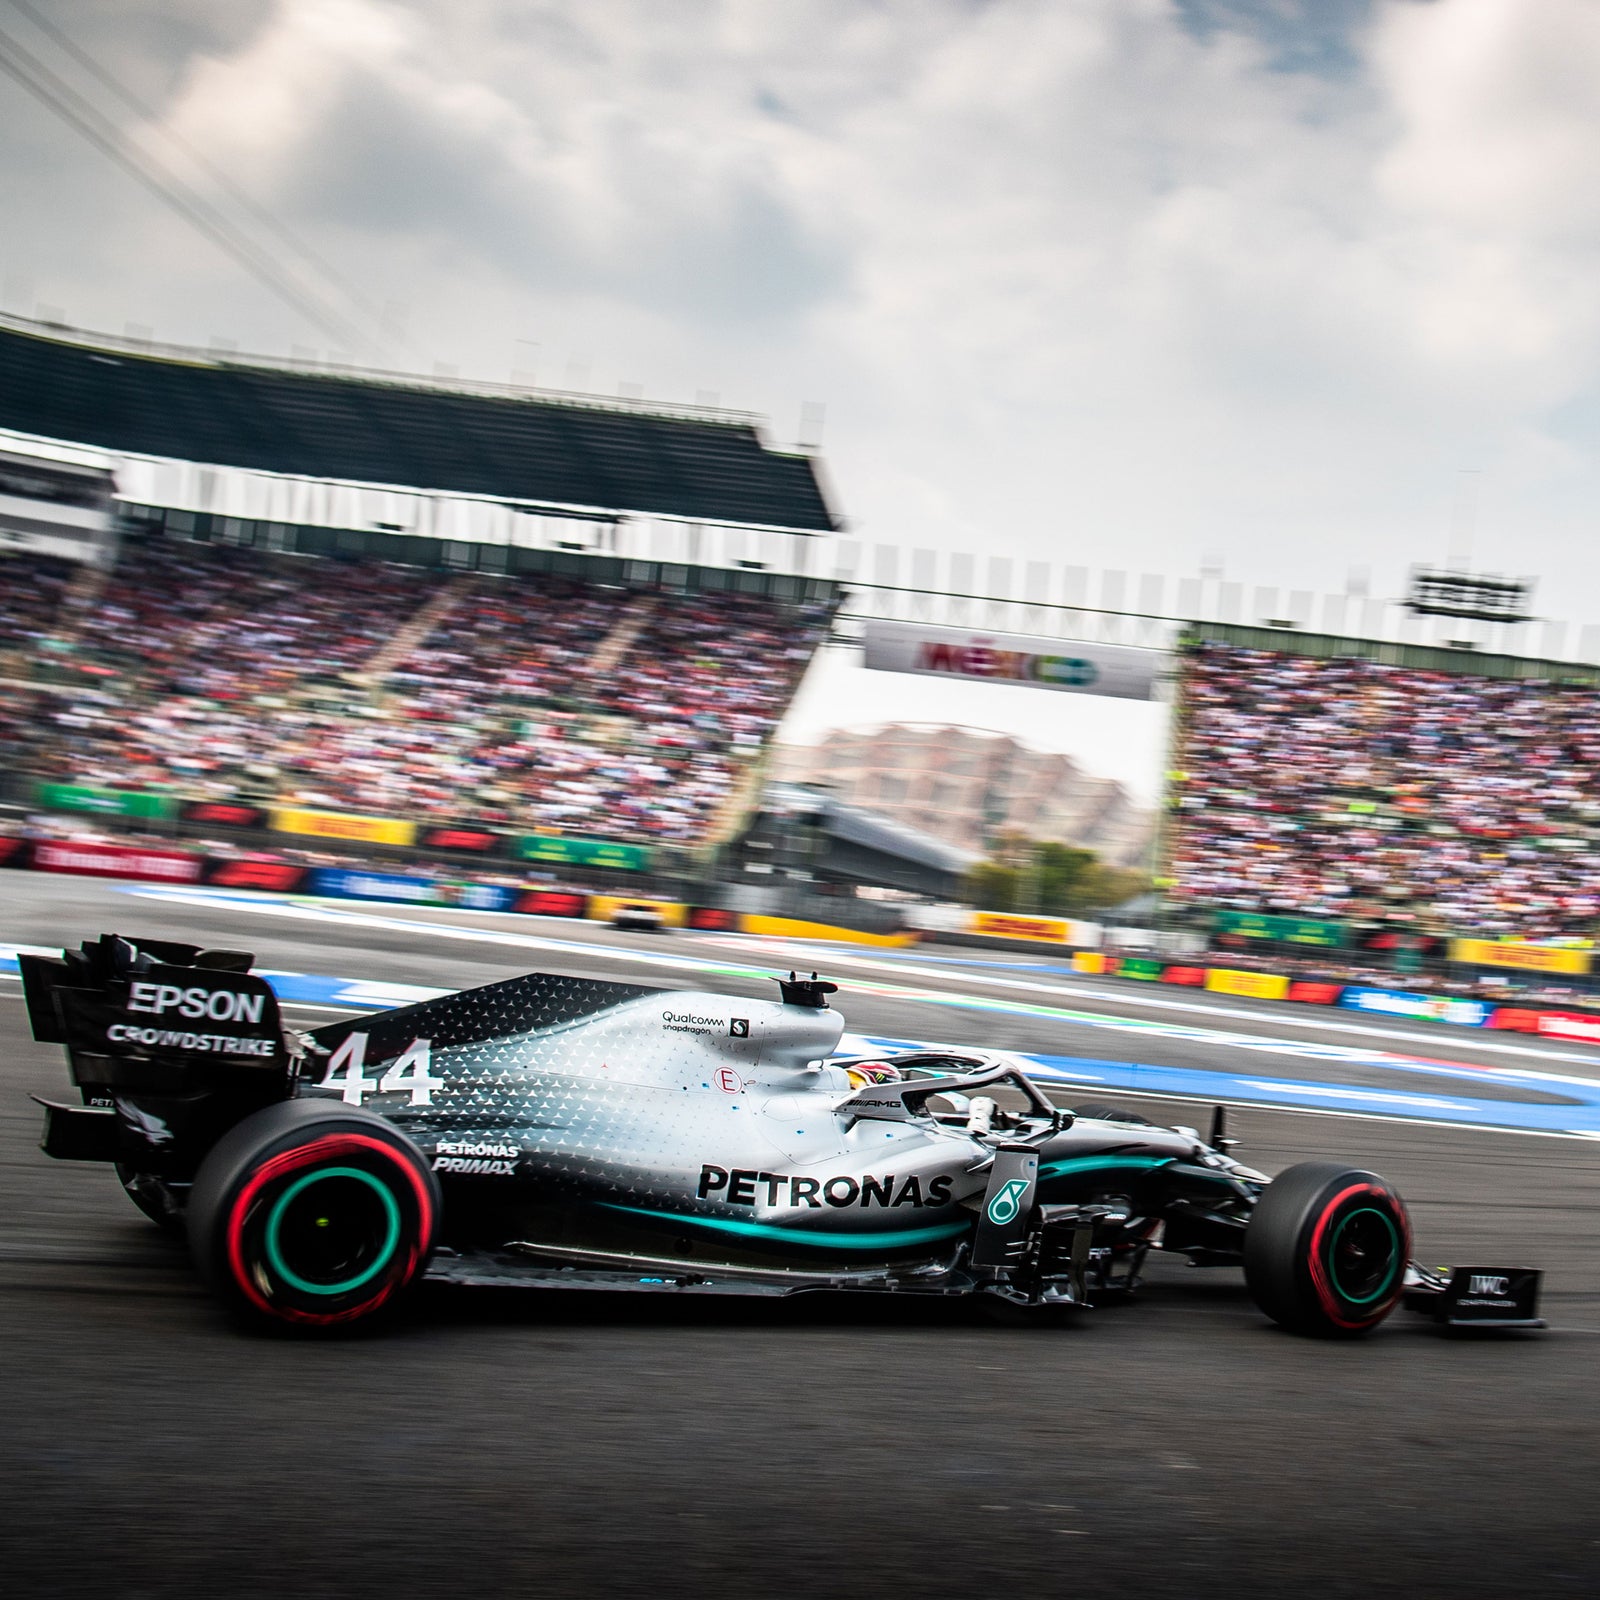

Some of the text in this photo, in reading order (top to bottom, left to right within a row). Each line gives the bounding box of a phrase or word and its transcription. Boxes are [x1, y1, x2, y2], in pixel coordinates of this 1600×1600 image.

[127, 982, 265, 1023] EPSON
[662, 1010, 725, 1027] Qualcomm
[662, 1023, 712, 1036] snapdragon
[106, 1024, 277, 1057] CROWDSTRIKE
[312, 1031, 444, 1107] 44
[721, 1070, 736, 1092] E
[865, 1100, 902, 1108] AMG
[436, 1142, 519, 1158] PETRONAS
[431, 1157, 521, 1176] PRIMAX
[696, 1164, 954, 1209] PETRONAS
[1467, 1275, 1510, 1296] IWC
